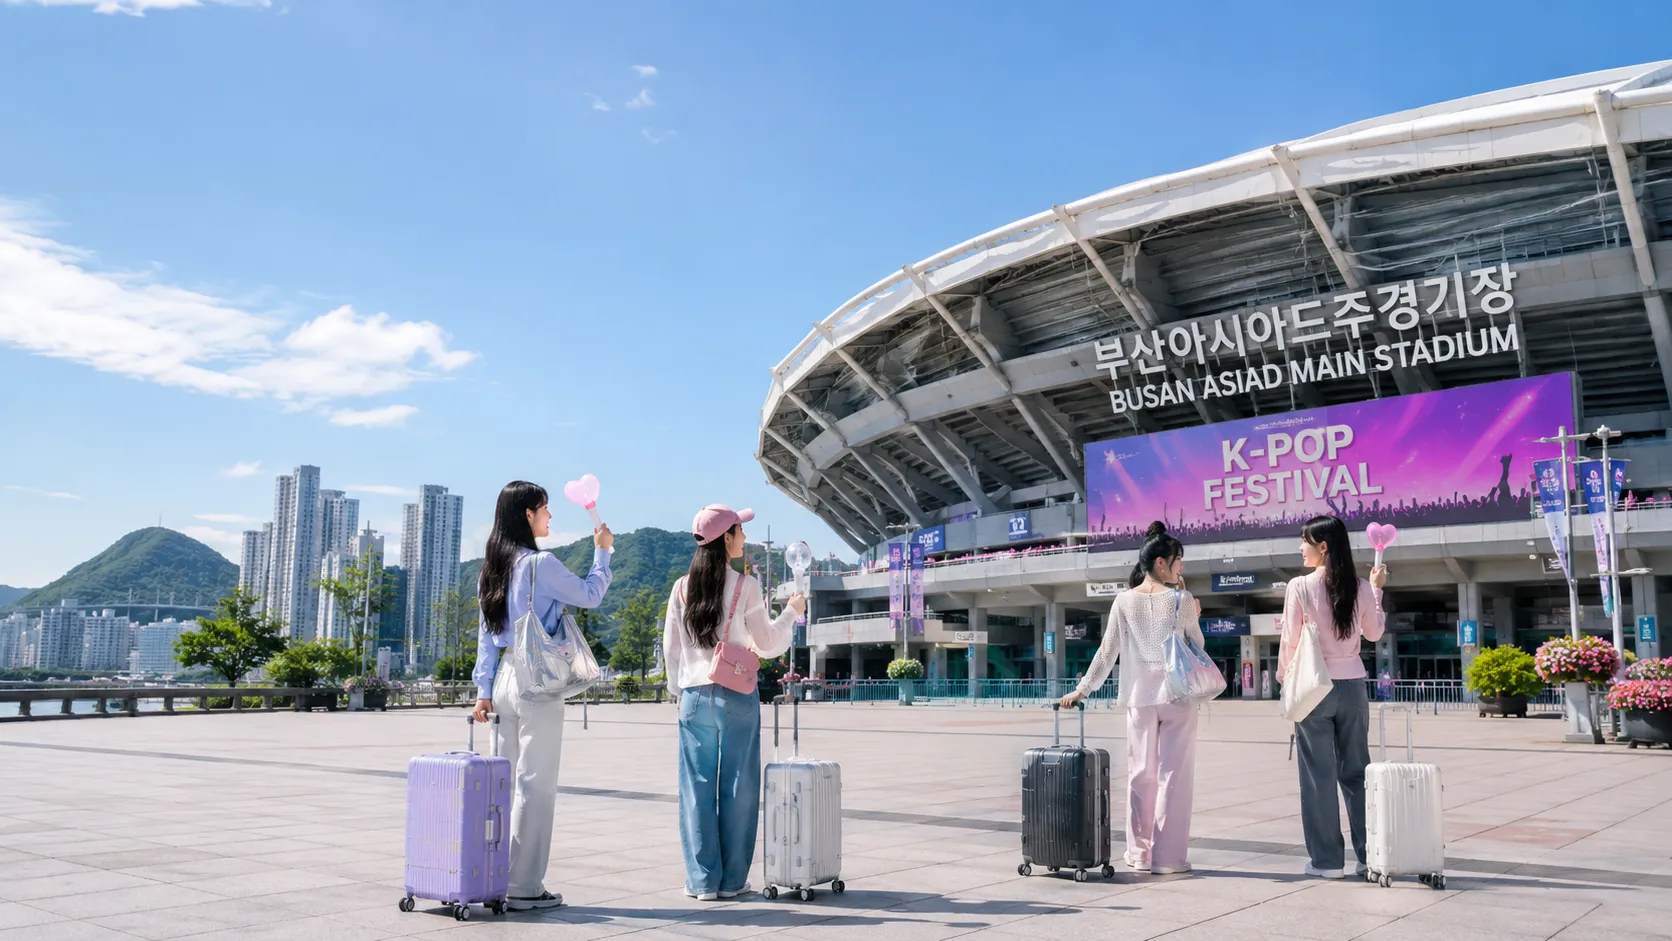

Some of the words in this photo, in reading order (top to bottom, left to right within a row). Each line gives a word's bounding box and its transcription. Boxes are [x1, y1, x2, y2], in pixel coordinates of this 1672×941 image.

[1094, 262, 1517, 380] 부산아시아드주경기장
[1109, 378, 1195, 414] BUSAN
[1203, 363, 1283, 399] ASIAD
[1290, 349, 1366, 385] MAIN
[1374, 323, 1519, 371] STADIUM
[1222, 424, 1354, 473] K-POP
[1203, 462, 1383, 510] FESTIVAL
